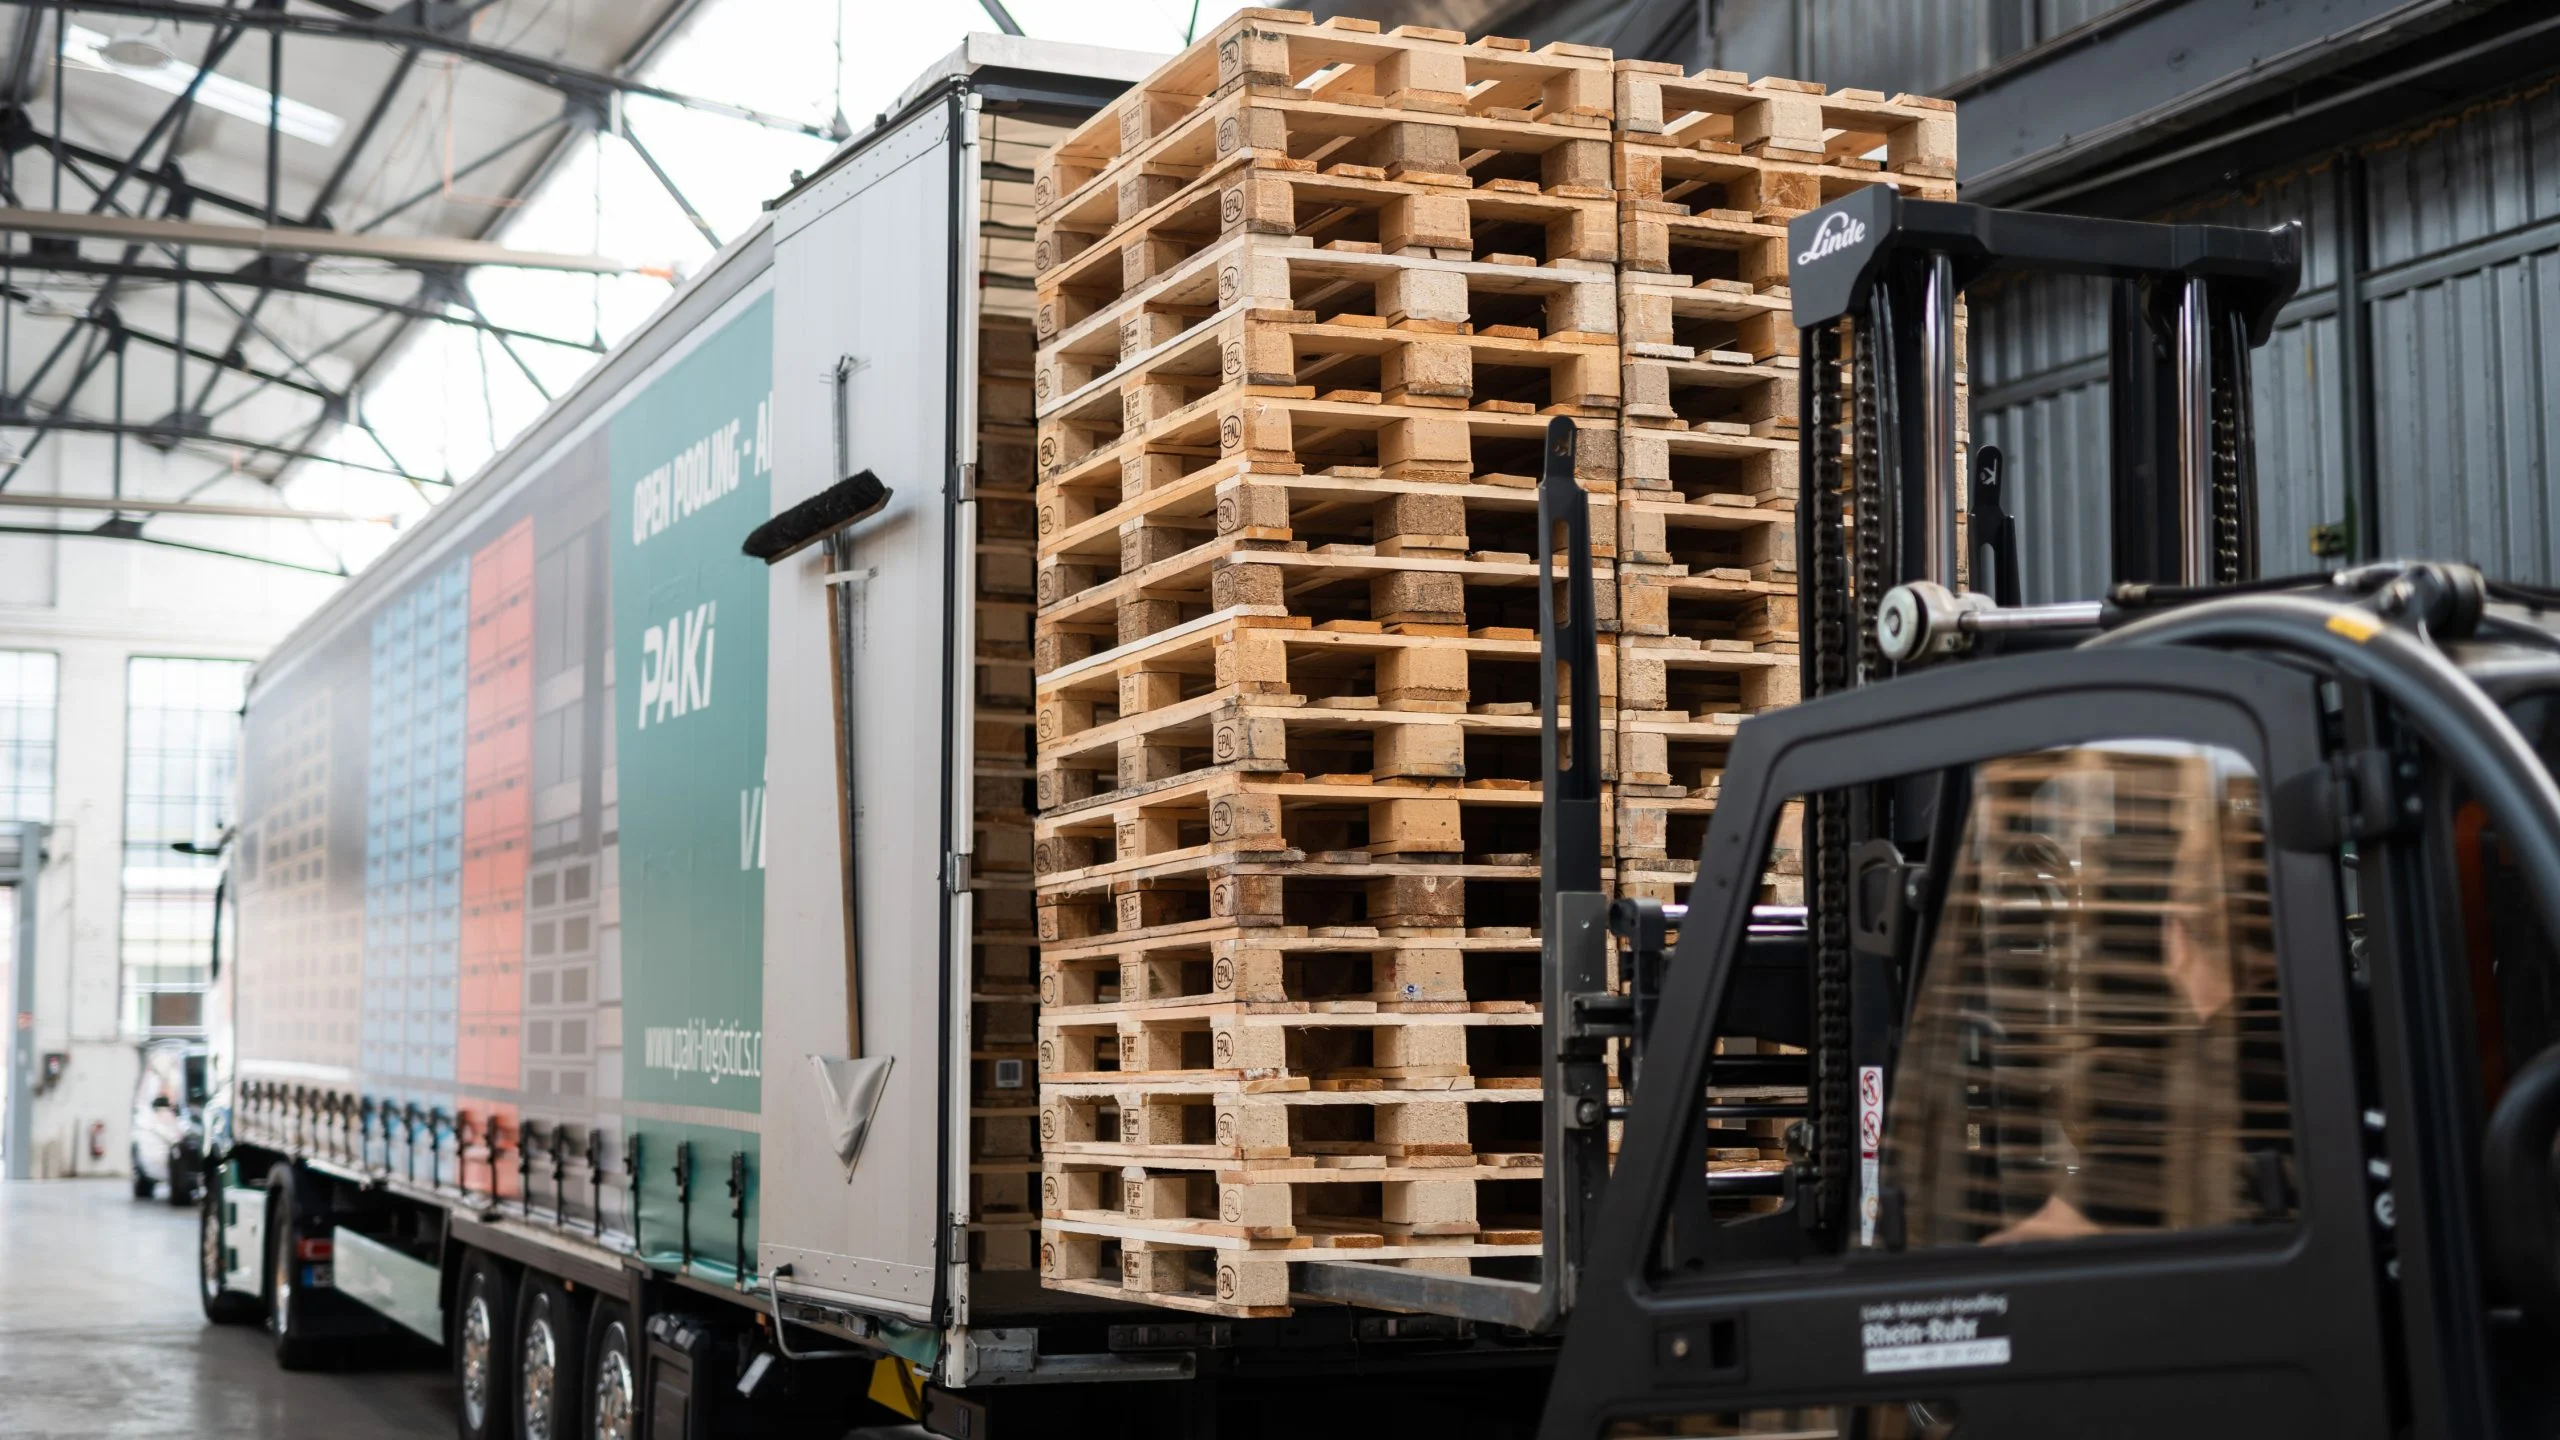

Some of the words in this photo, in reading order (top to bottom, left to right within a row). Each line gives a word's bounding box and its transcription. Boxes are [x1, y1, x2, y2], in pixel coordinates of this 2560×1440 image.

[1797, 211, 1866, 266] Linde
[633, 461, 671, 546] OPEN
[673, 417, 740, 524] POOLING
[1862, 1317, 1979, 1347] Rhein-Ruhr
